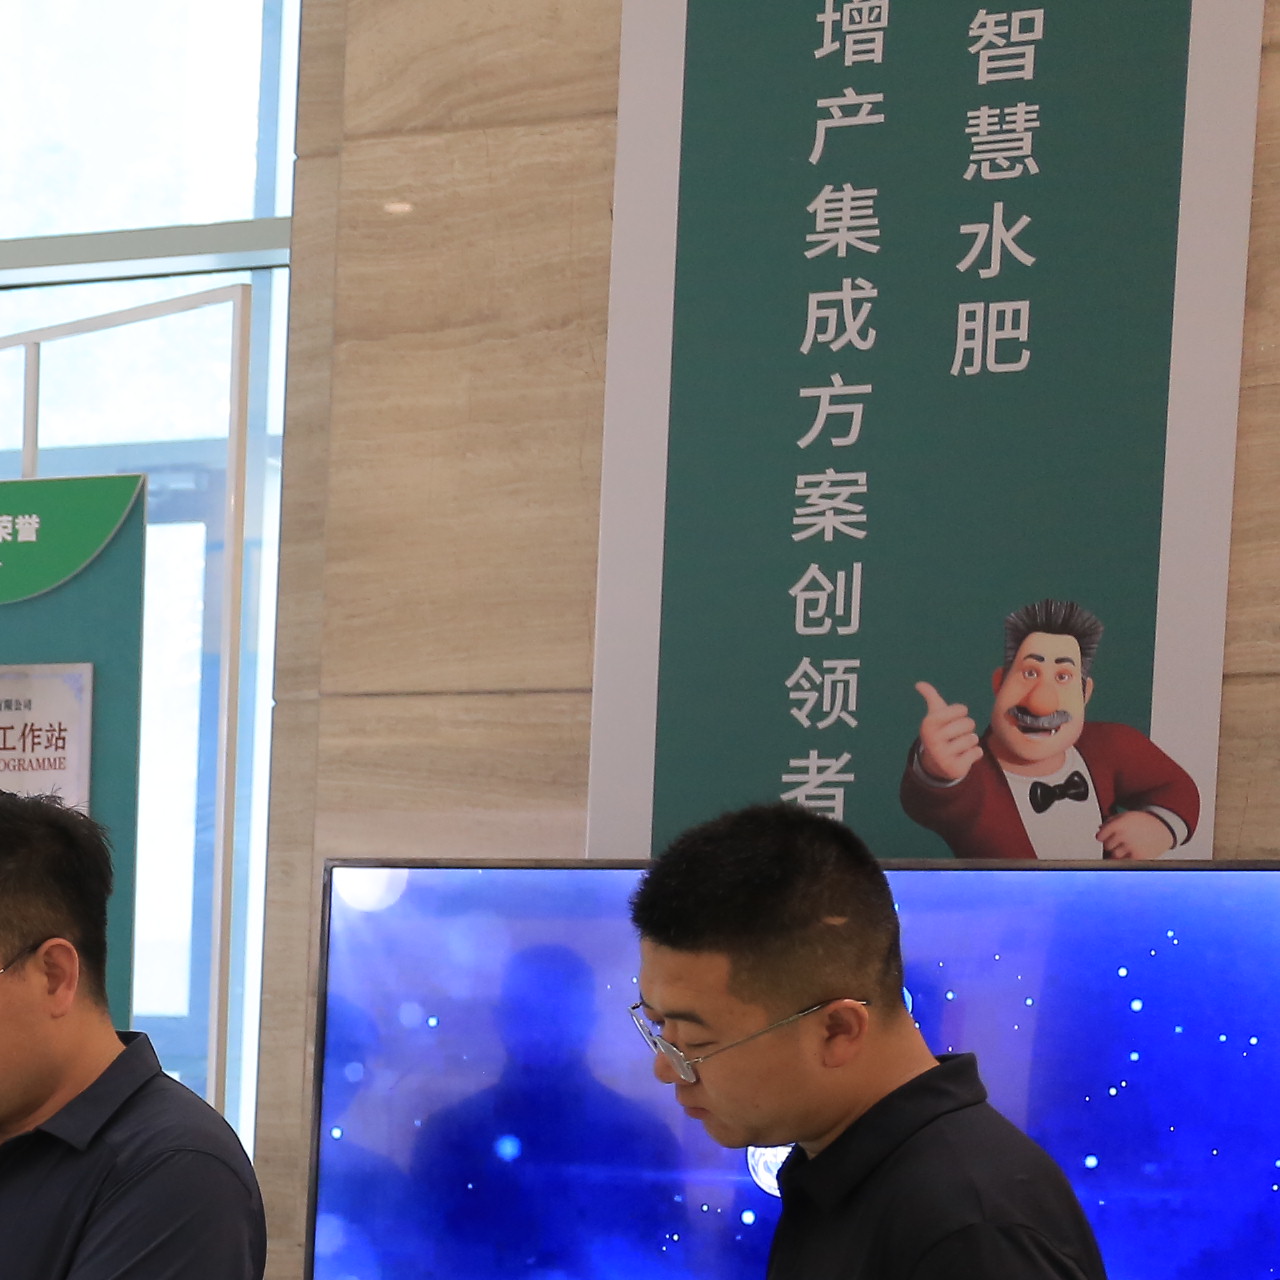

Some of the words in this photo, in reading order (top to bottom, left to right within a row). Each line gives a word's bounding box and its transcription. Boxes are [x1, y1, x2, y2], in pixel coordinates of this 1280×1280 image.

[780, 0, 890, 822] 增产集成方案创领者
[950, 8, 1045, 376] 智慧水肥
